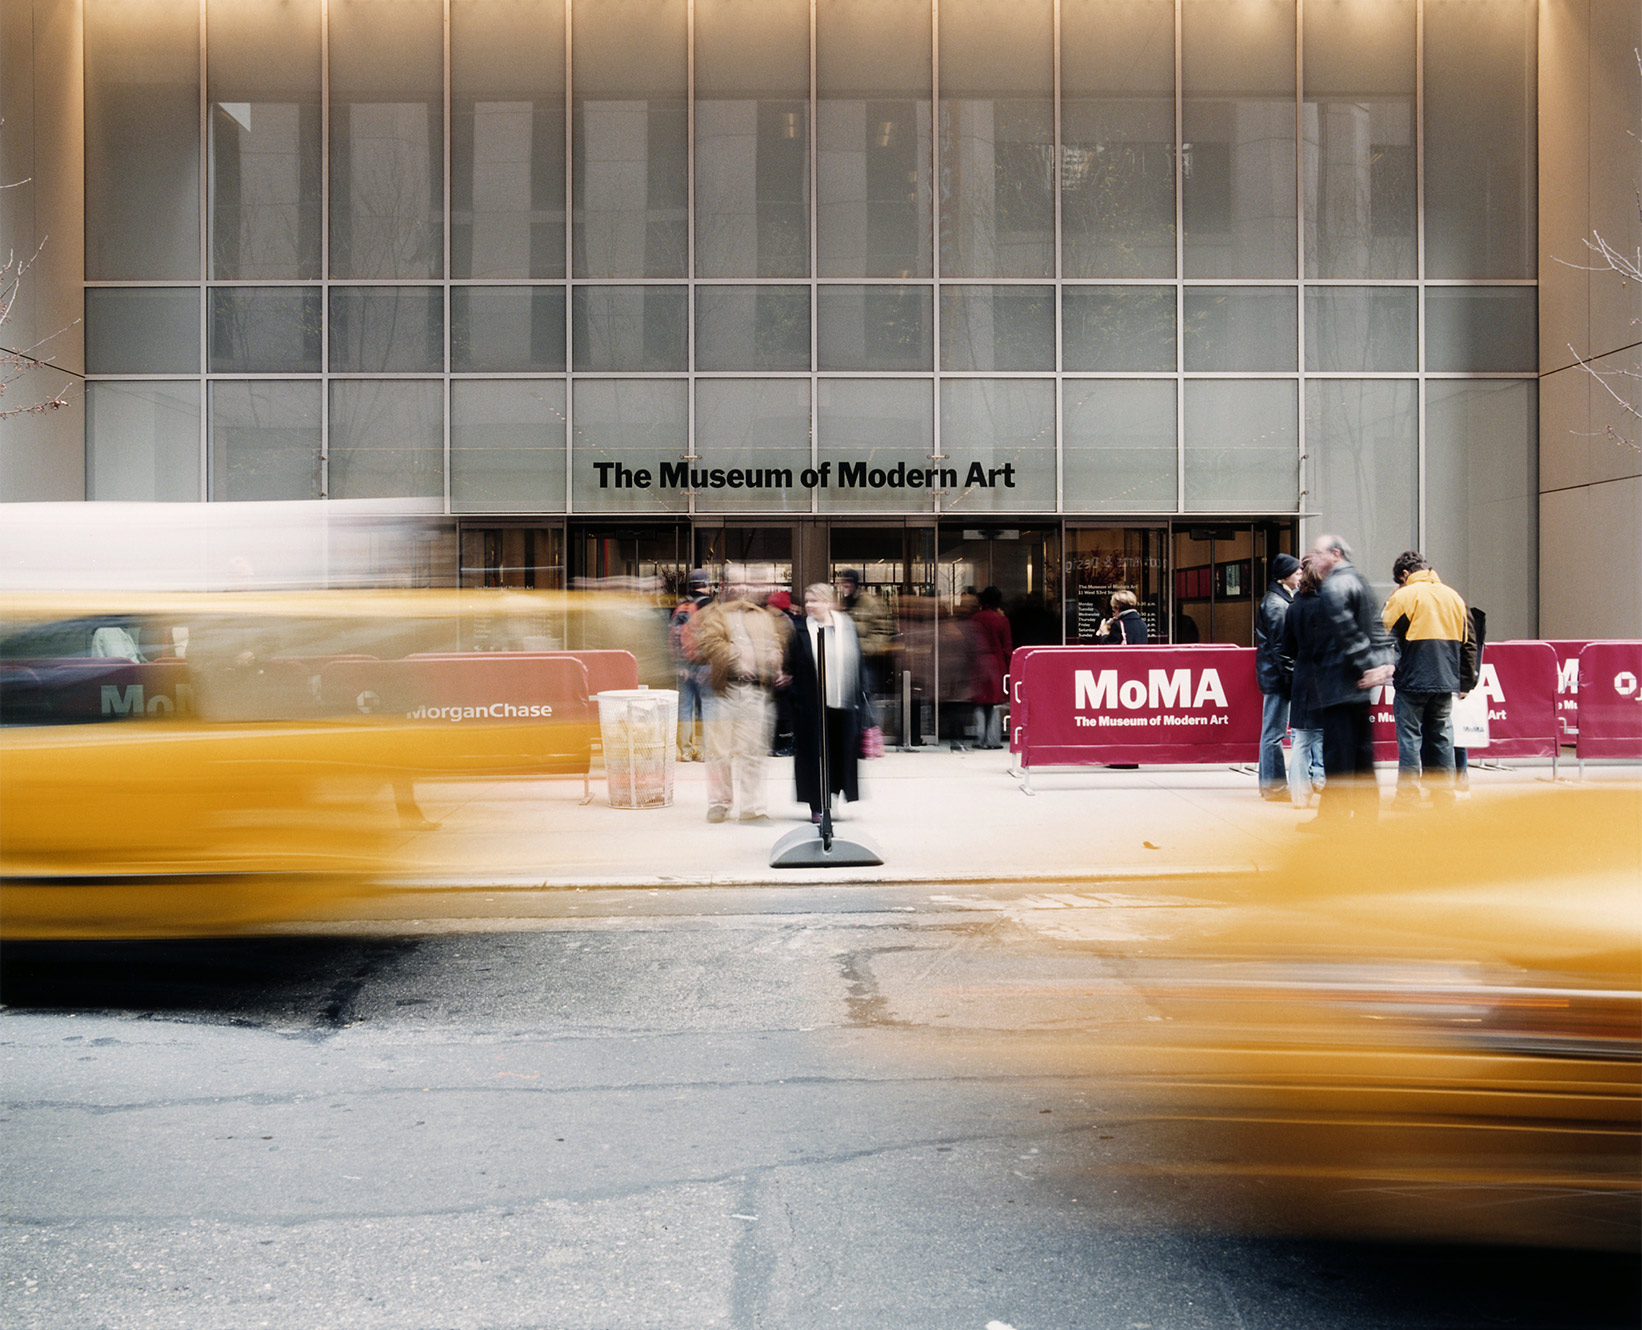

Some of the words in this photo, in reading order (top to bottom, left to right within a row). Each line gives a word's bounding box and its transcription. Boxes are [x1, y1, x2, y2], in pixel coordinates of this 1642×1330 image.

[593, 462, 652, 488] The
[659, 462, 793, 488] Museum
[800, 462, 831, 488] of
[838, 462, 957, 488] Modern
[964, 462, 1016, 488] Art
[1075, 668, 1229, 709] MoMA
[407, 703, 553, 722] MorganChase
[1074, 716, 1097, 727] The
[1098, 716, 1148, 727] Museum
[1149, 715, 1161, 726] of
[1163, 715, 1208, 726] Modern
[1210, 715, 1229, 725] Art
